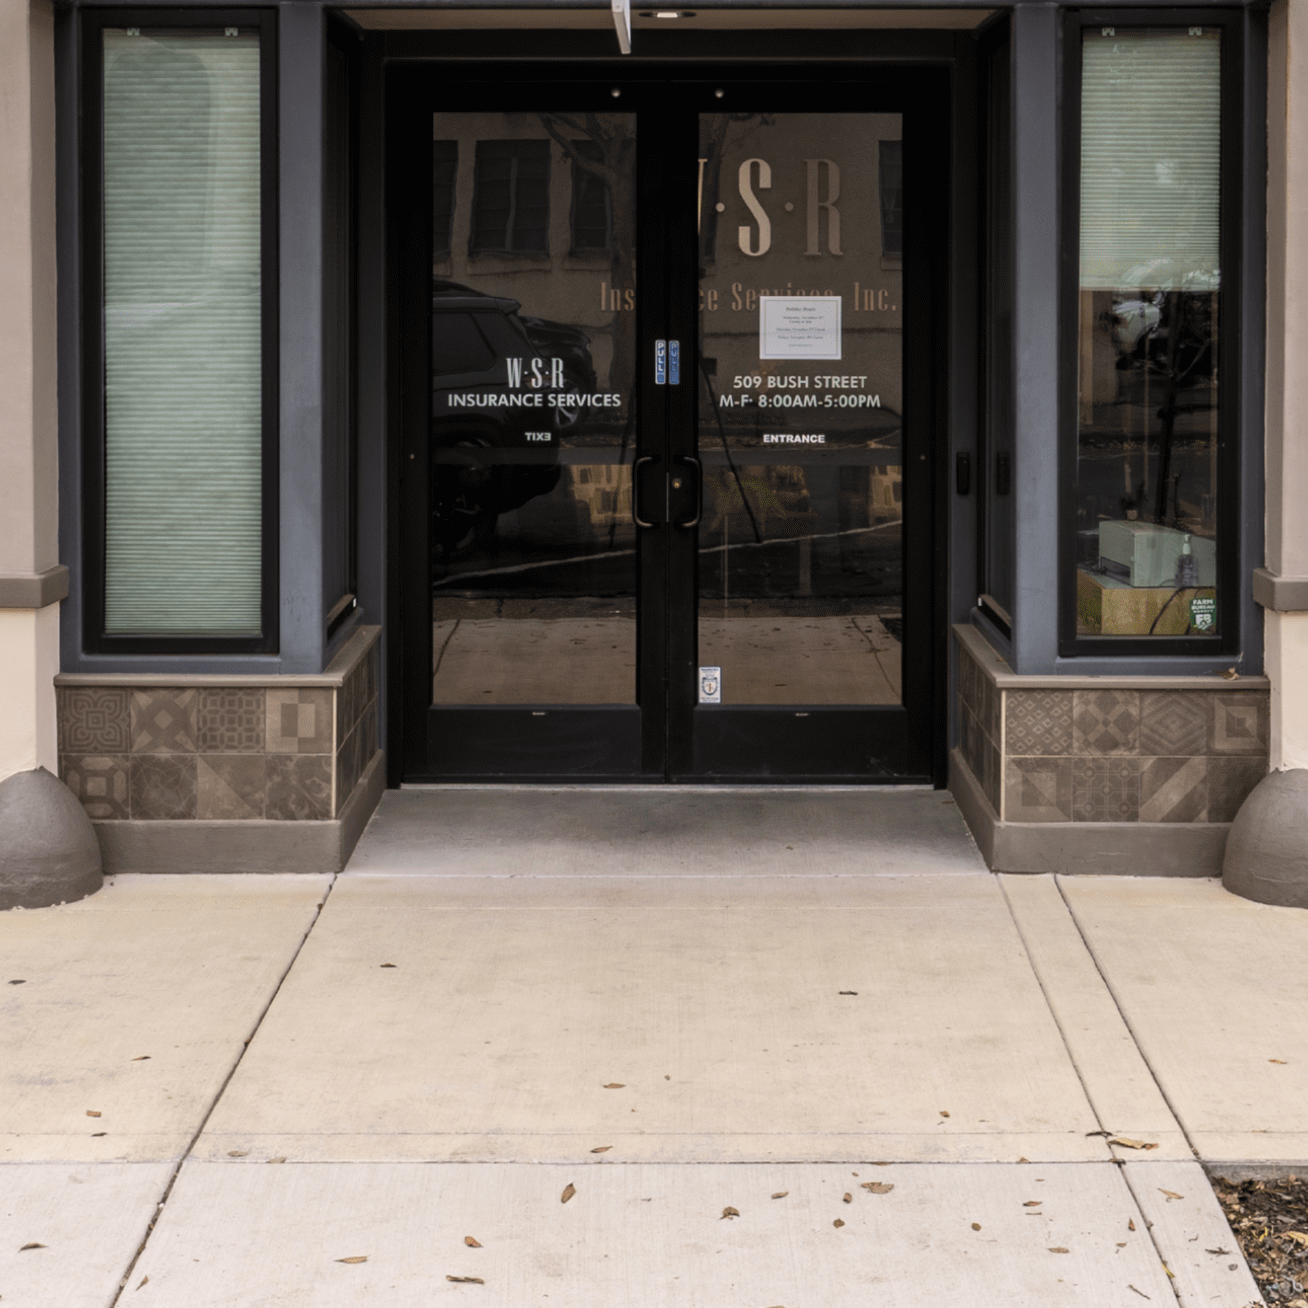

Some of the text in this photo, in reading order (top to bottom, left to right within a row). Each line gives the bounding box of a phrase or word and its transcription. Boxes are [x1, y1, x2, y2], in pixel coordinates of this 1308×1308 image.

[853, 282, 897, 311] Inc.
[657, 342, 665, 372] PULL
[733, 376, 868, 389] 509 BUSH STREET
[448, 394, 622, 407] INSURANCE SERVICES
[758, 394, 881, 408] 8:00AM-5:00PM
[763, 434, 826, 443] ENTRANCE
